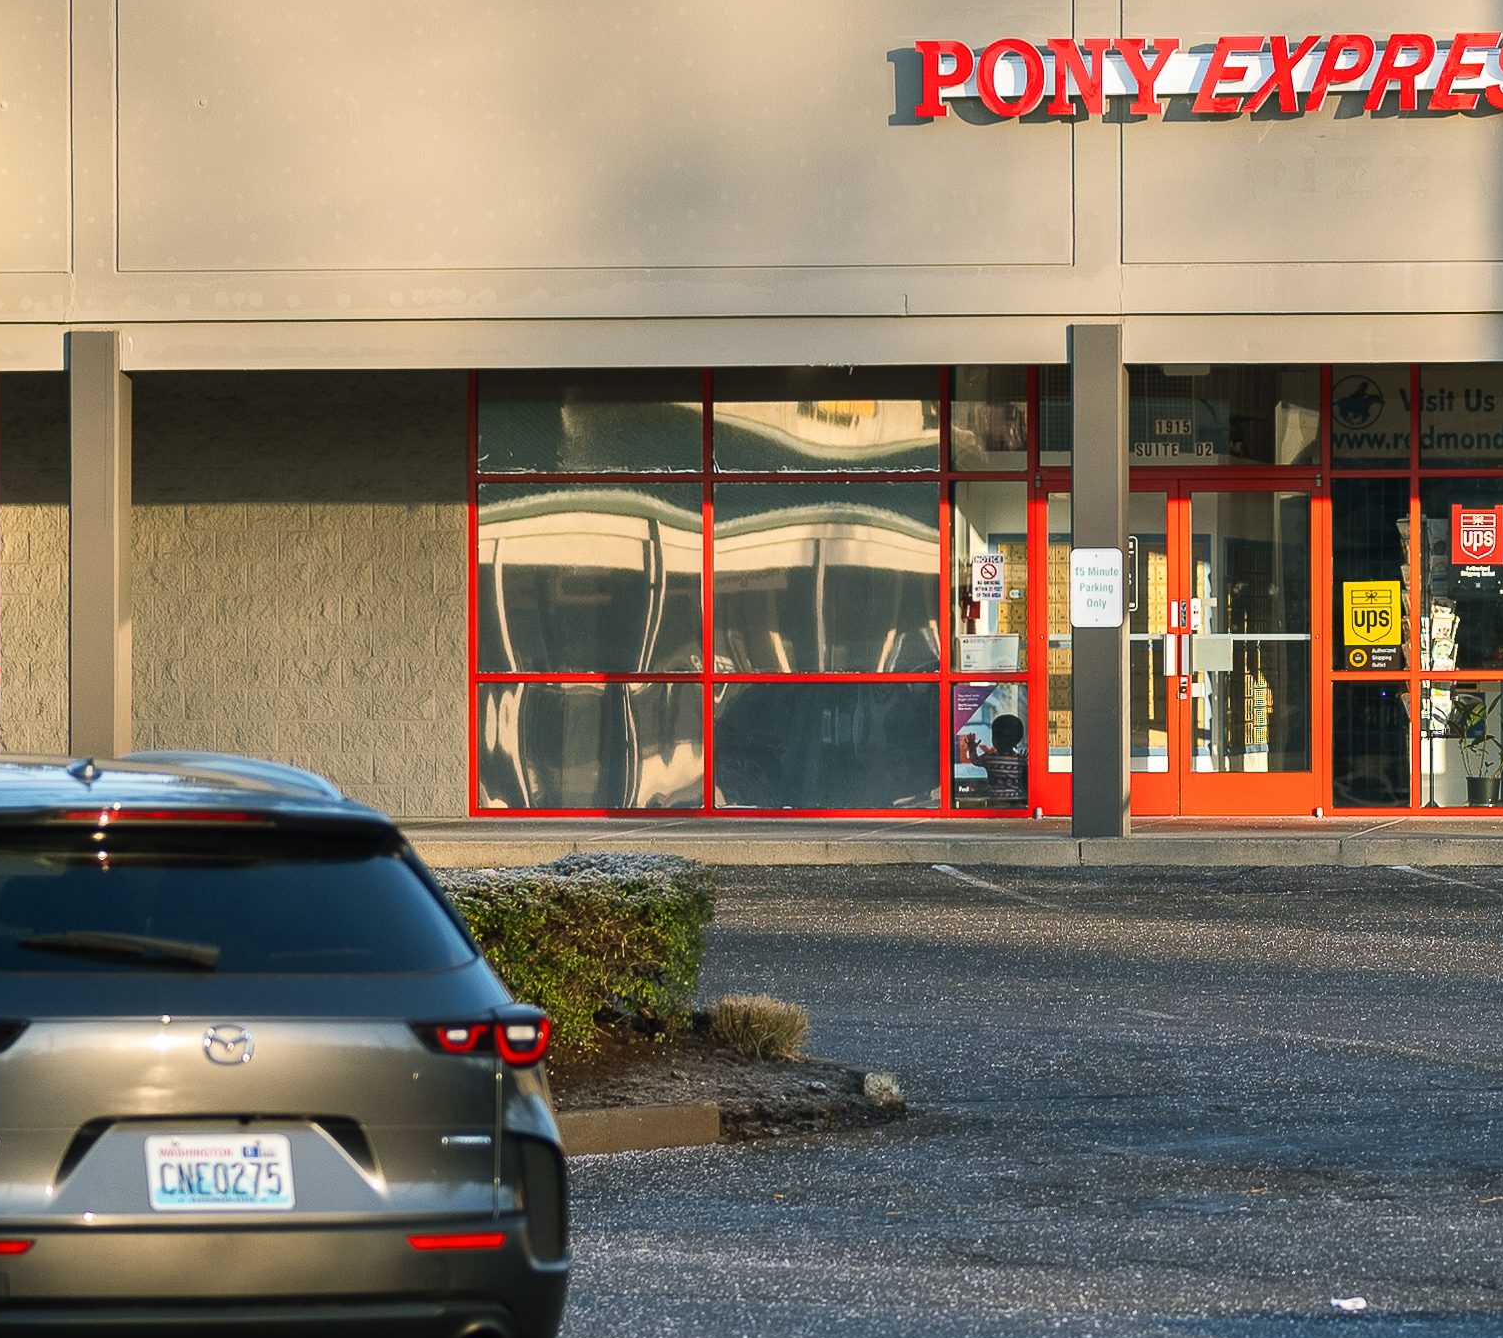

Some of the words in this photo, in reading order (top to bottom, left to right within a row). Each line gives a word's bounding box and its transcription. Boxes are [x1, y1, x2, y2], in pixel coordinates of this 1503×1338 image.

[915, 38, 1183, 116] PONY
[1464, 388, 1496, 413] Us
[1157, 420, 1191, 434] 1915
[1135, 443, 1178, 457] SUITE
[1196, 443, 1213, 457] D2
[1463, 530, 1494, 552] ups
[1075, 566, 1085, 576] 15
[1088, 566, 1119, 576] Minute
[1079, 582, 1114, 594] Parking
[1086, 598, 1108, 609] Only
[1354, 609, 1390, 633] ups
[160, 1147, 234, 1158] WASHINGTON
[160, 1162, 282, 1195] CNE0275
